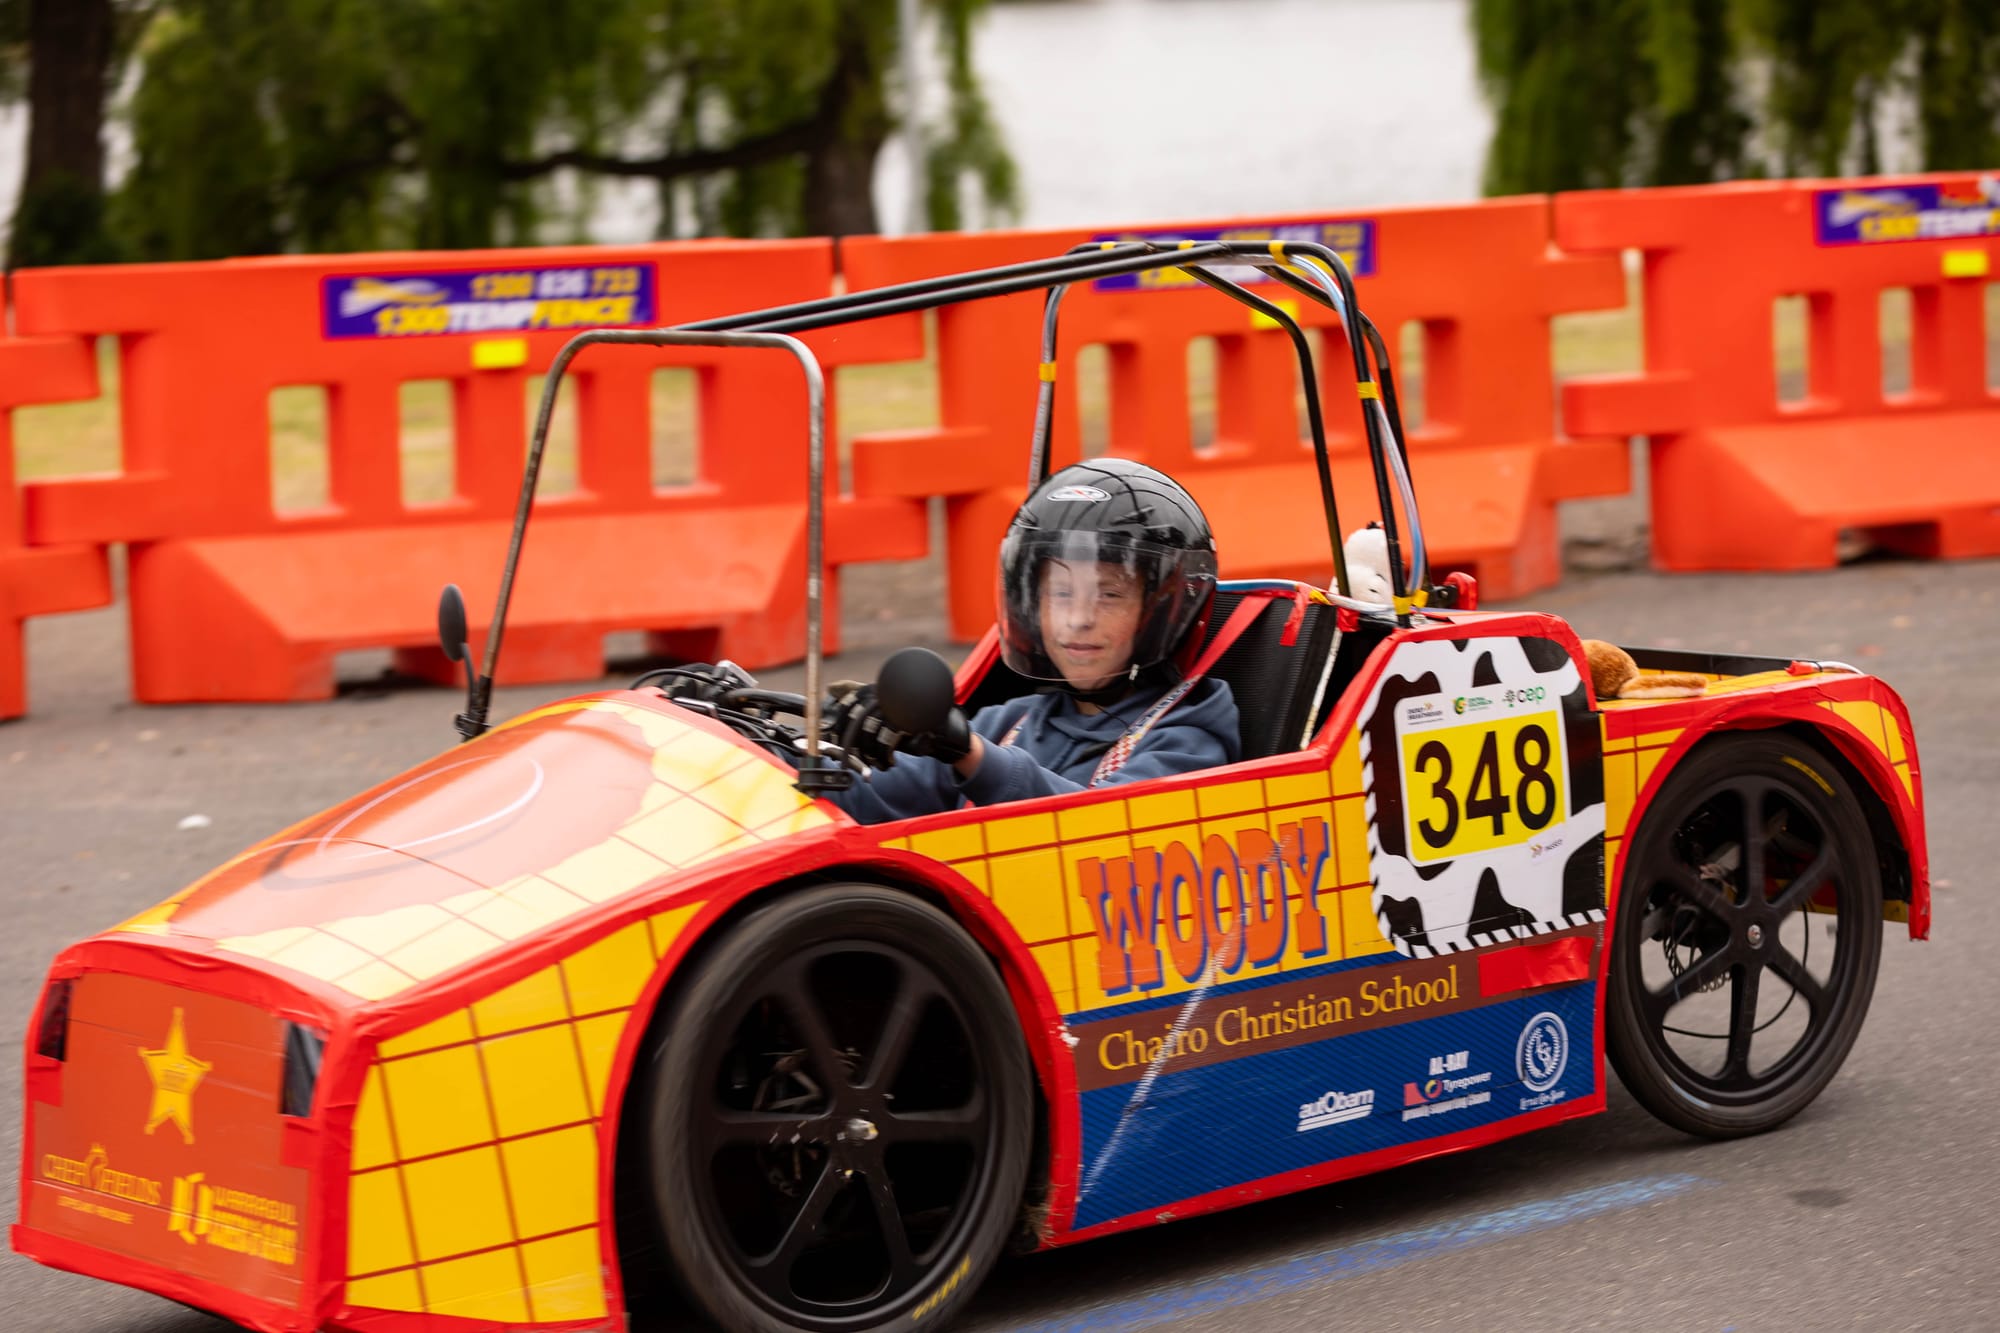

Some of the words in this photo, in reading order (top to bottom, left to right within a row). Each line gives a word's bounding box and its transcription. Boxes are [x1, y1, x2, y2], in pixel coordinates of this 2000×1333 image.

[374, 295, 638, 336] 1300TEMPFENCE
[470, 272, 534, 300] 1300
[590, 266, 640, 294] 733
[1415, 724, 1556, 849] 348
[1077, 816, 1329, 996] WOODY
[1098, 1024, 1208, 1071] Chairo
[1215, 994, 1354, 1046] Christian
[1359, 964, 1460, 1018] School
[1442, 1072, 1492, 1092] Tyrepower
